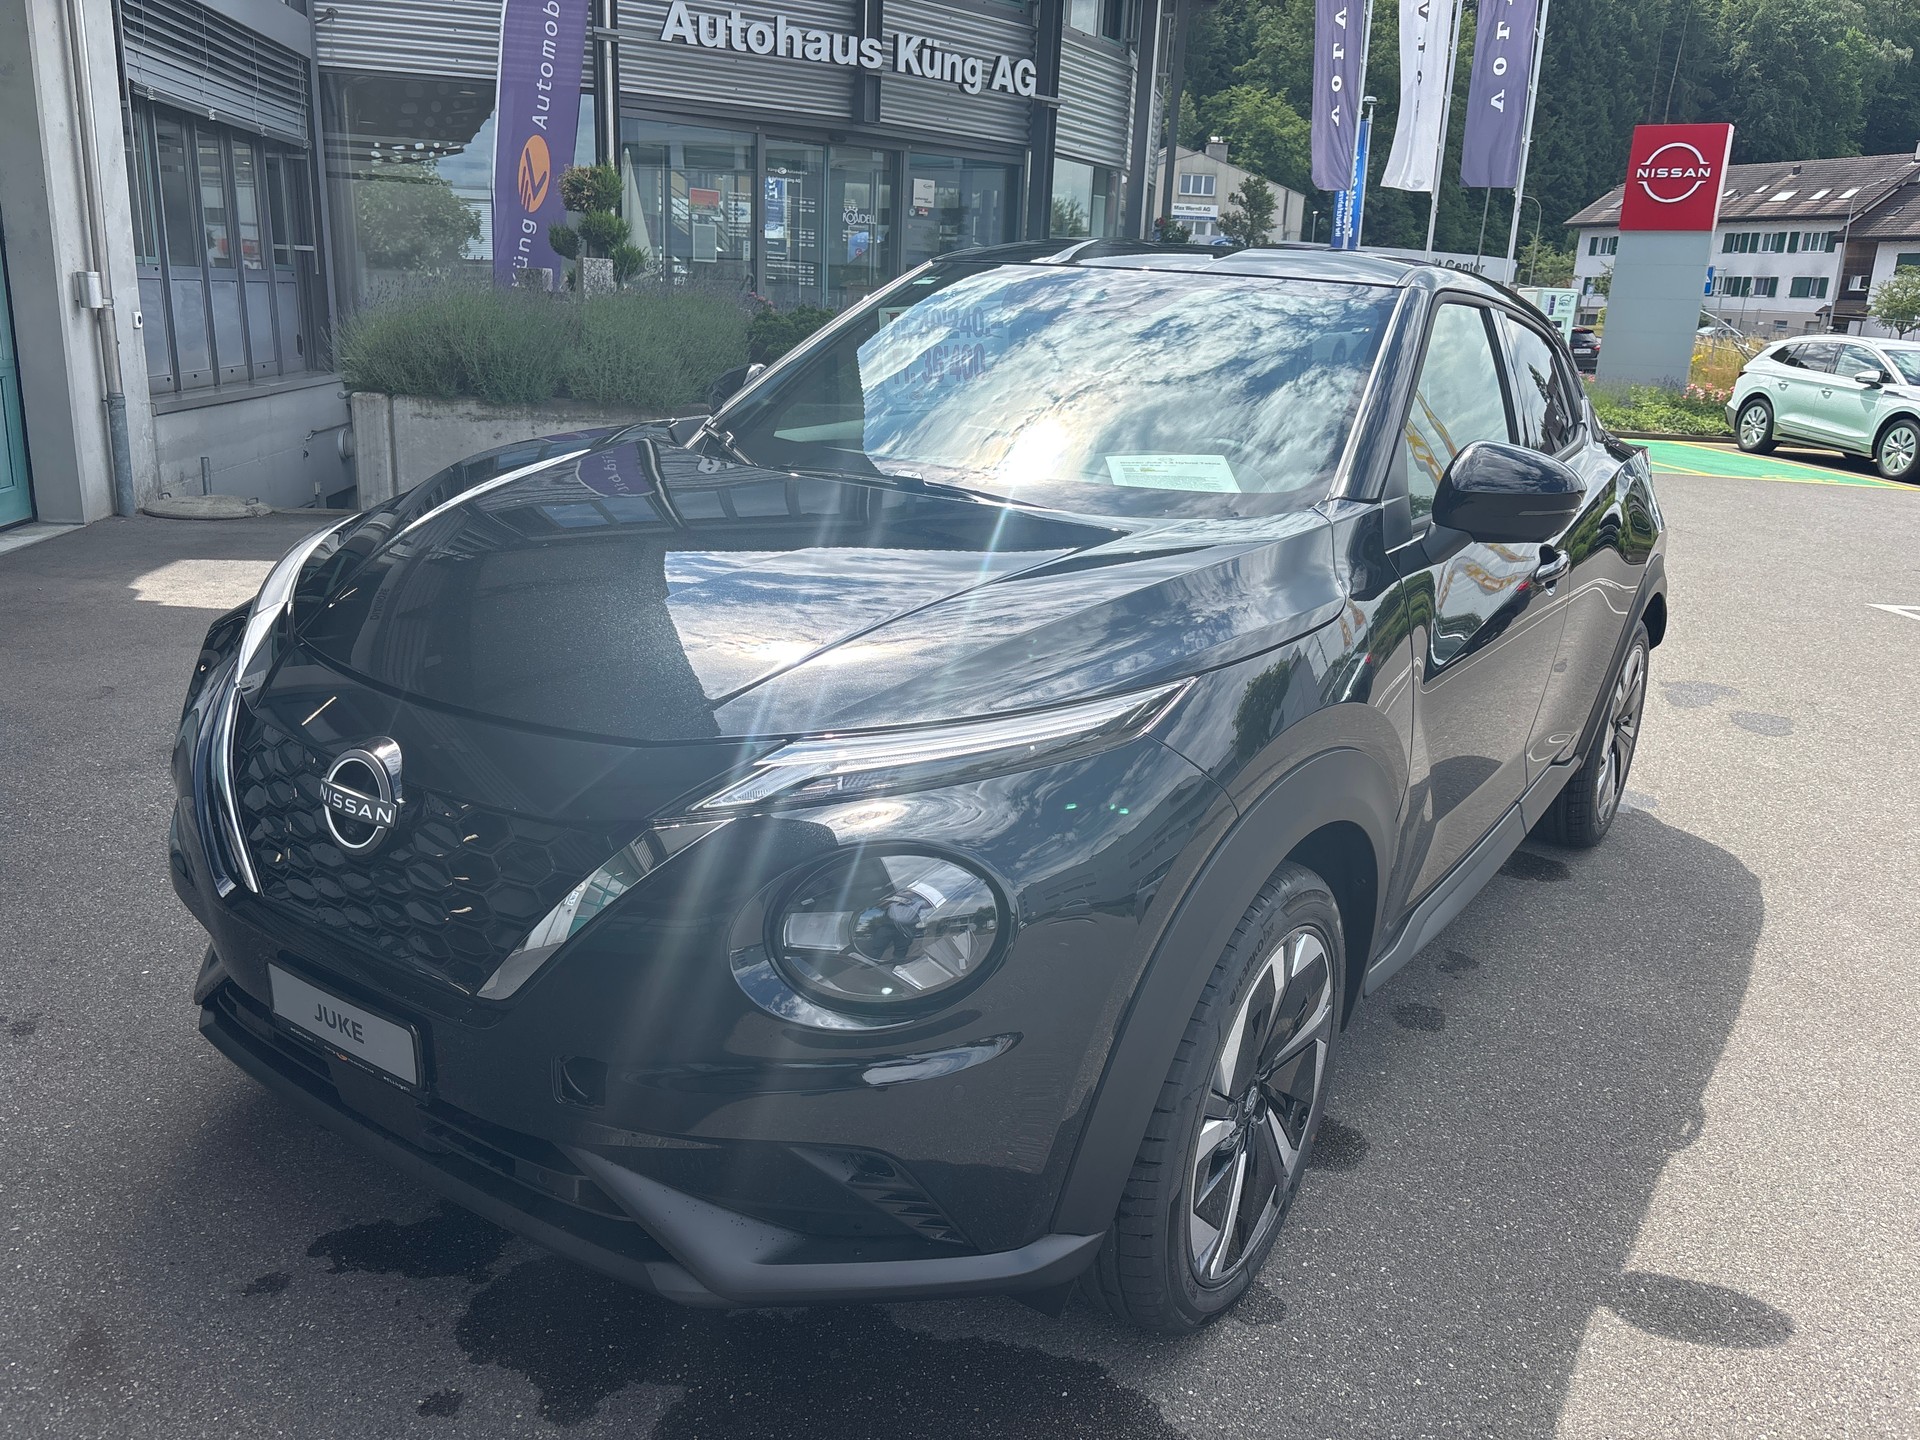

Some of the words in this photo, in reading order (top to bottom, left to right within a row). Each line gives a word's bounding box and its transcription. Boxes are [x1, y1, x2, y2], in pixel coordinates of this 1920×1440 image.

[532, 0, 560, 130] Automob
[660, 0, 884, 69] Autohaus
[896, 33, 983, 95] Küng
[990, 55, 1037, 97] AG
[1636, 167, 1711, 178] NISSAN
[320, 783, 392, 823] NISSAN
[314, 1003, 365, 1045] JUKE
